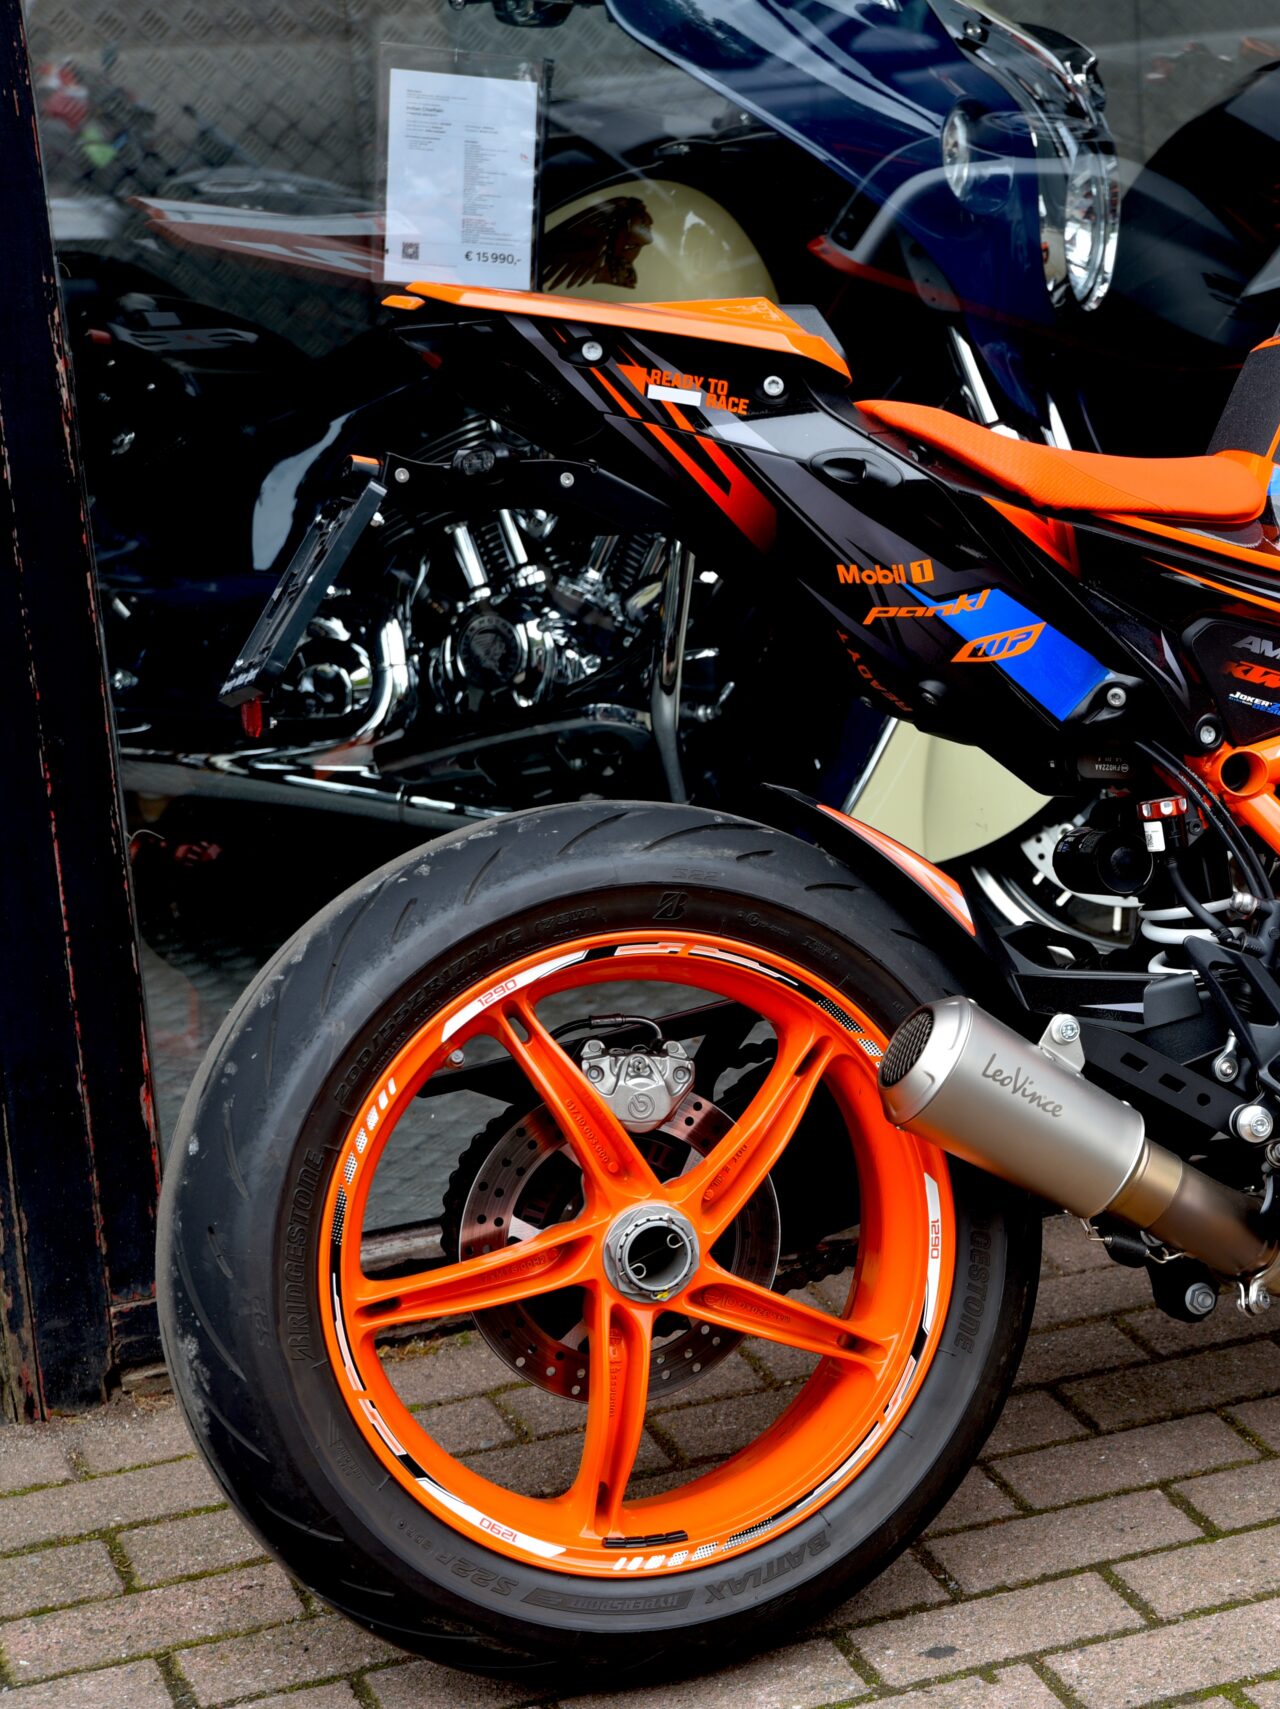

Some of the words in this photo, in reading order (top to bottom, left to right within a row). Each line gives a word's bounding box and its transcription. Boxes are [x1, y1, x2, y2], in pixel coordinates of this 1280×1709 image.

[465, 250, 473, 262] €
[650, 368, 704, 389] READY
[707, 378, 729, 396] TO
[705, 393, 750, 415] RACE
[837, 564, 907, 585] Mobil
[862, 589, 991, 625] pankl
[847, 648, 914, 712] READY
[477, 978, 517, 1007] 1290
[981, 1053, 1063, 1117] LeoVince
[284, 1148, 325, 1361] BRIDGESTONE
[930, 1218, 940, 1260] 1290
[480, 1516, 517, 1543] 1290
[705, 1529, 831, 1604] BATTLAX
